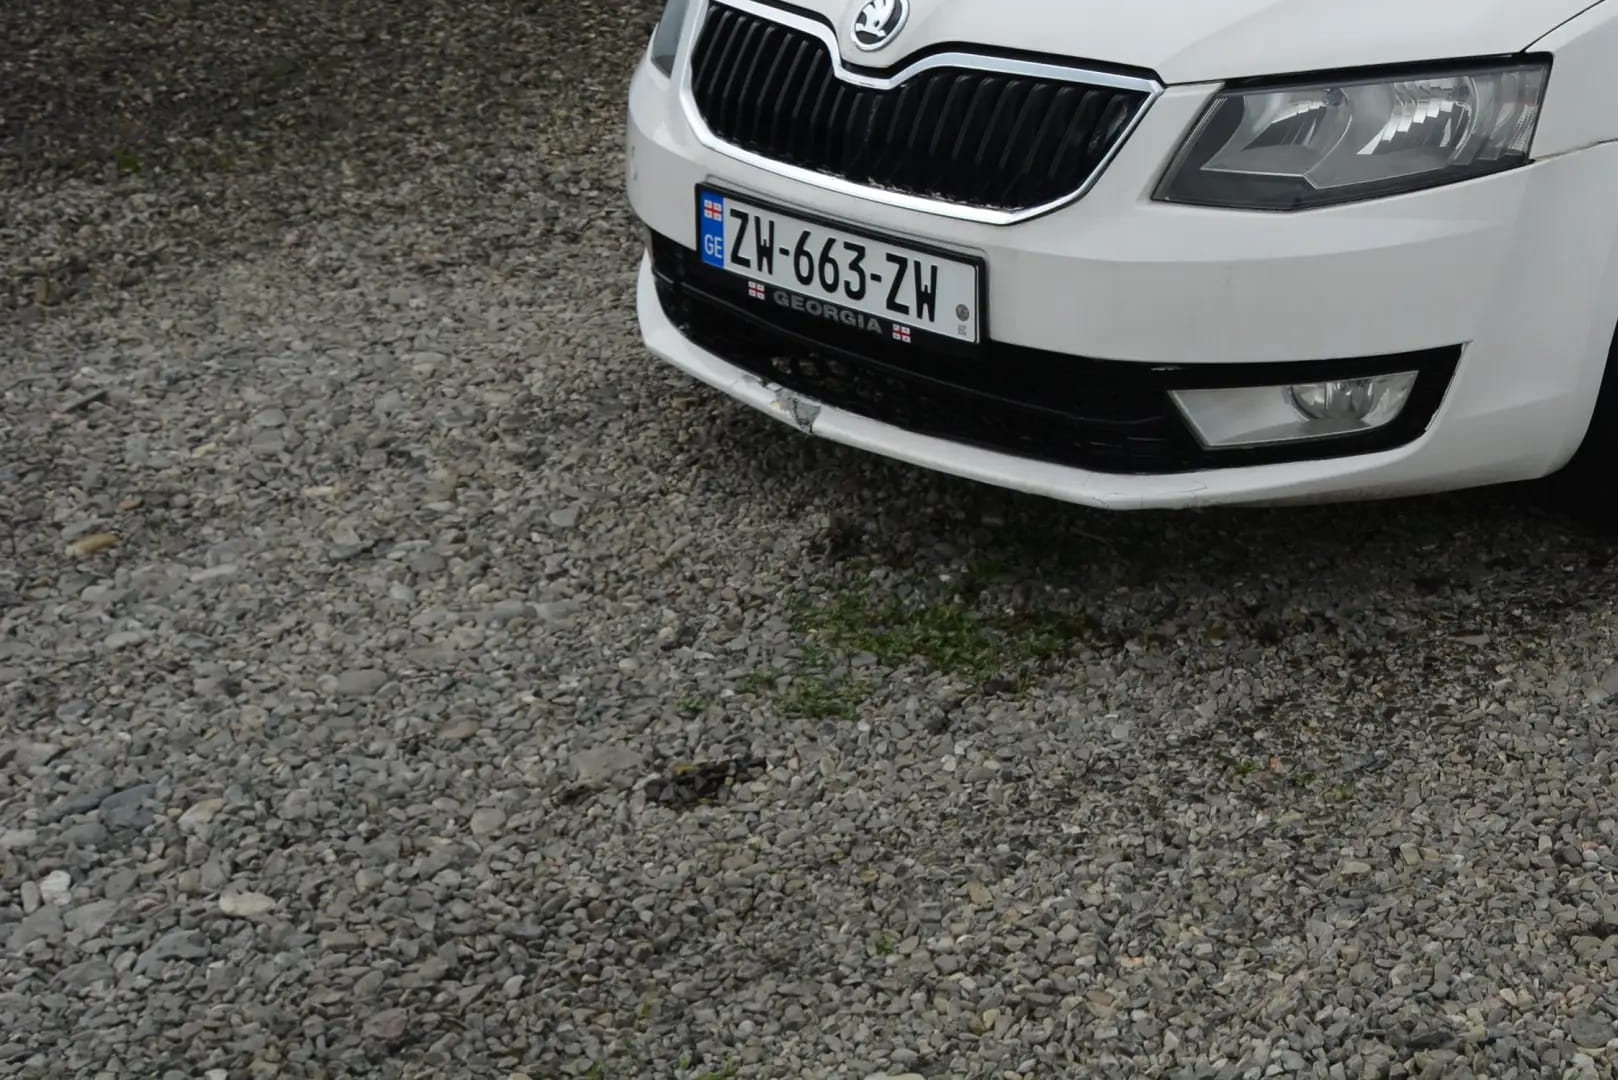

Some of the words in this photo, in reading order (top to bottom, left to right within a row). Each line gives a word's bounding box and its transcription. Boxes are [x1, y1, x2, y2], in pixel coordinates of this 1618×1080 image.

[703, 232, 724, 260] GE
[728, 207, 939, 323] ZW-663-ZW
[772, 289, 884, 335] GEORGIA
